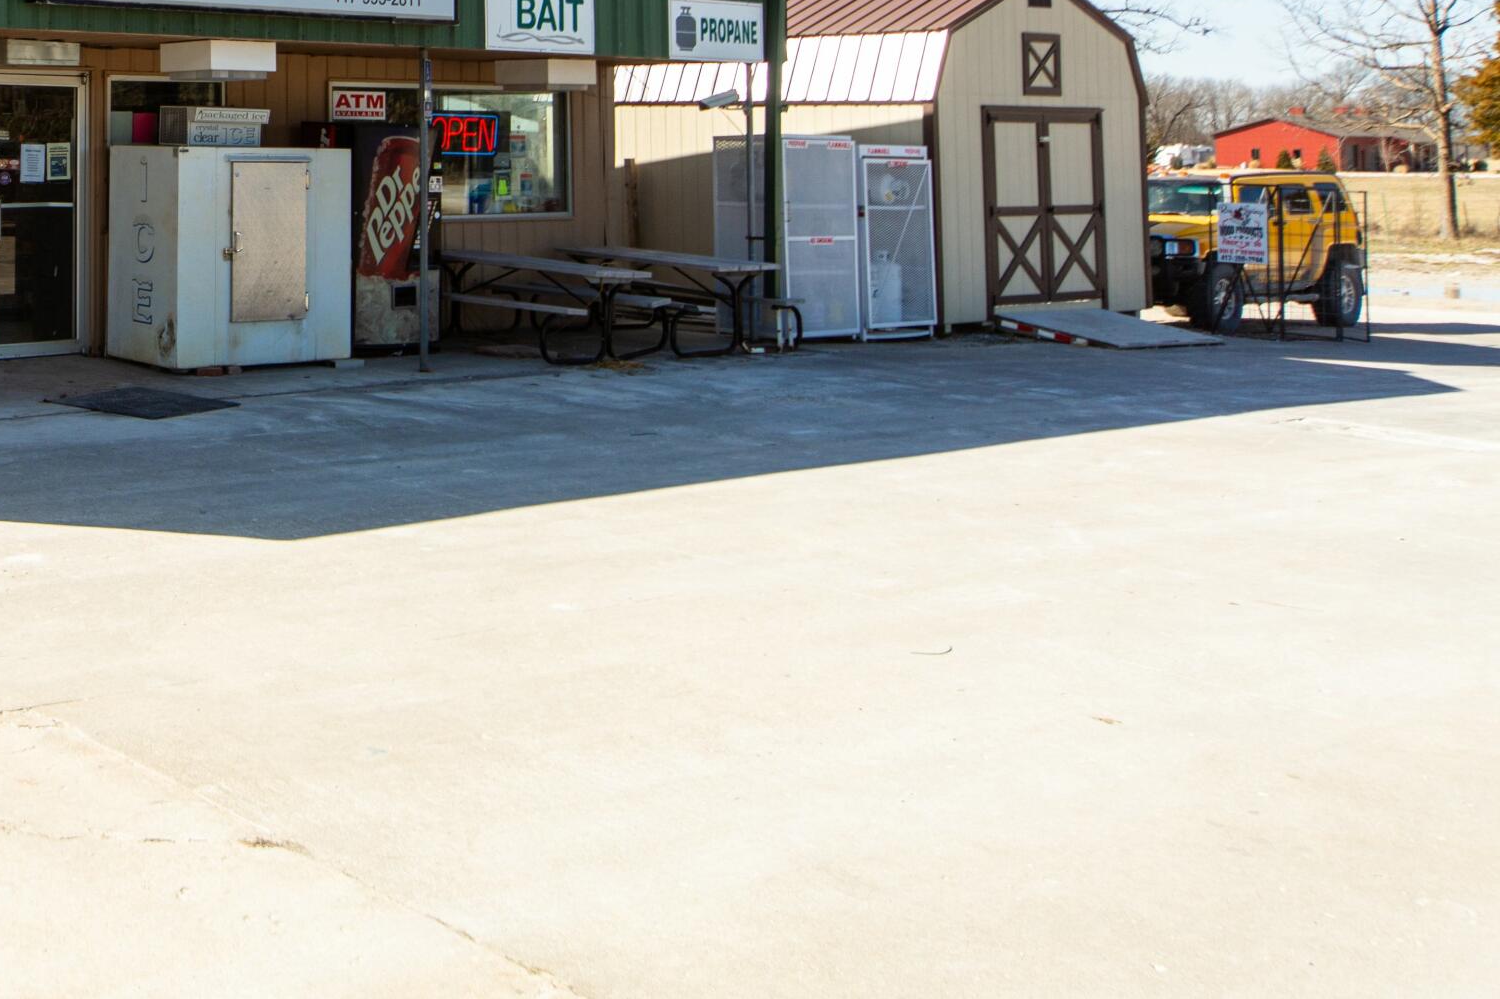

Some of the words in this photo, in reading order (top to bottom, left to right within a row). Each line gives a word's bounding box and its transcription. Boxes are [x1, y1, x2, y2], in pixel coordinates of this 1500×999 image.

[700, 17, 758, 44] PROPANE
[335, 94, 384, 109] ATM
[200, 111, 249, 121] packaged
[193, 132, 220, 143] clear
[222, 126, 256, 145] ICE
[432, 117, 495, 152] OPEN
[375, 165, 405, 218] Dr
[366, 166, 421, 265] Peppe
